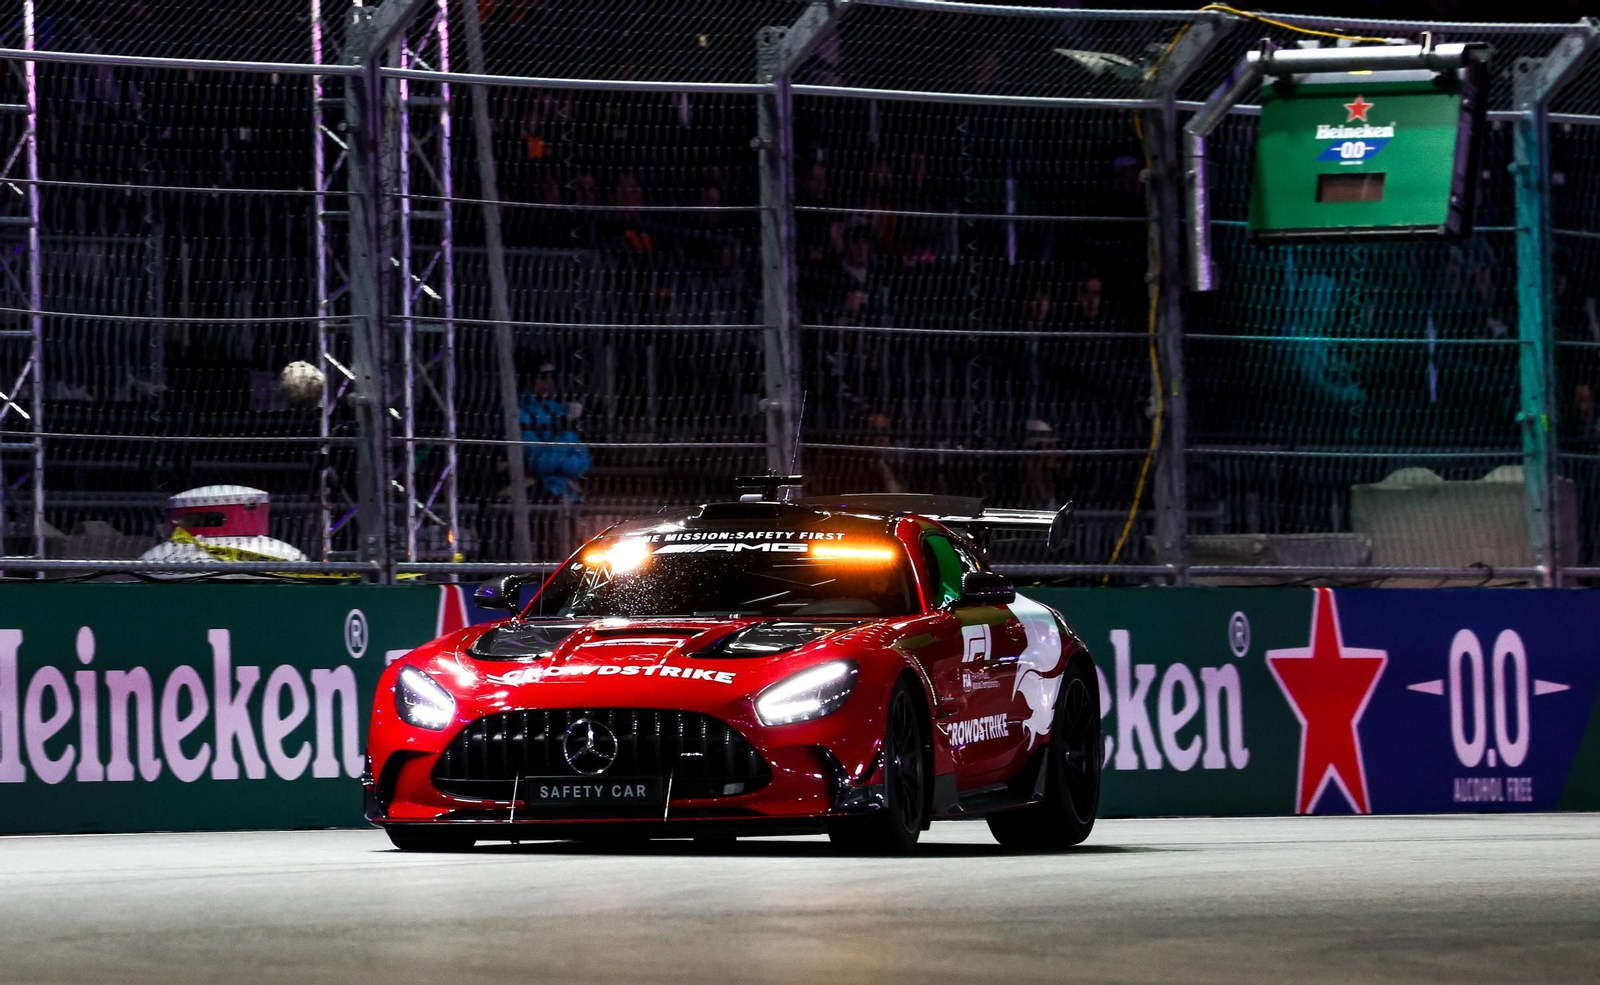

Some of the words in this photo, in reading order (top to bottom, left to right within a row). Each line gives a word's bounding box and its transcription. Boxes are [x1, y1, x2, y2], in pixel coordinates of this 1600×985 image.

[1315, 123, 1395, 139] Heineken
[798, 532, 846, 541] FIRST
[698, 542, 809, 553] AMG
[1448, 628, 1531, 768] 0.0
[947, 713, 1009, 746] CROWDSTRIKE
[540, 784, 604, 799] SAFETY
[611, 784, 647, 798] CAR
[1453, 777, 1505, 802] ALCOHOL
[1506, 777, 1534, 802] FREE
